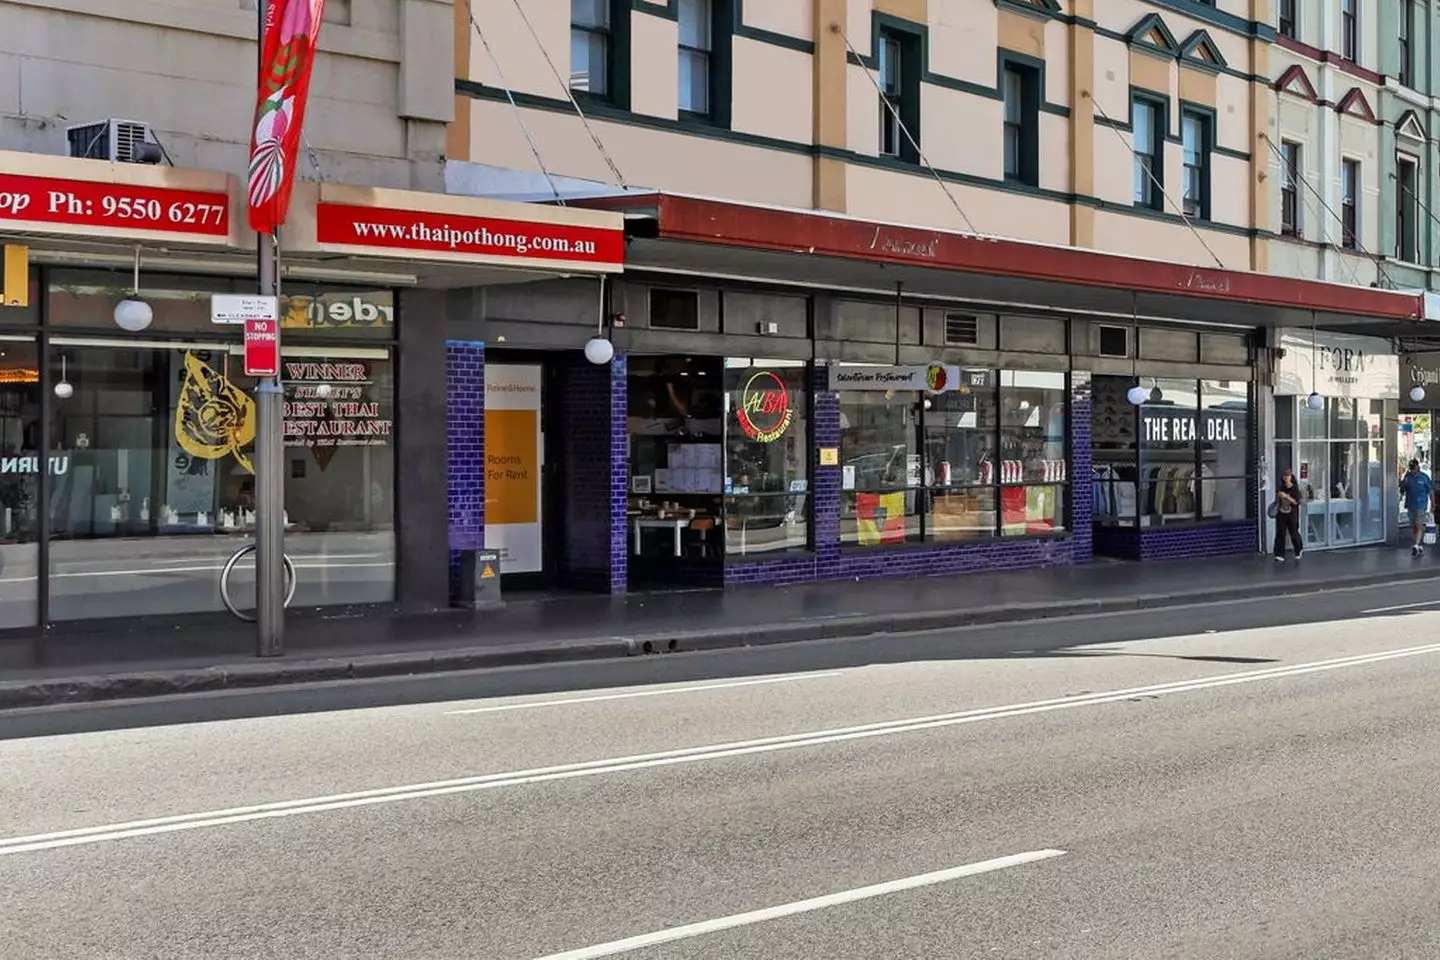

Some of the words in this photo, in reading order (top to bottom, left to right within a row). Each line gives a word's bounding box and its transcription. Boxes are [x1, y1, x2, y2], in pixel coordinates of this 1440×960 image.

[47, 191, 94, 215] Ph:
[102, 196, 162, 220] 9550
[168, 202, 225, 225] 6277
[353, 221, 597, 255] www.thaipothong.com.au
[254, 321, 268, 332] NO
[246, 333, 276, 341] STOPPING
[1319, 346, 1365, 372] FORA
[286, 363, 367, 380] WINNER
[283, 402, 327, 417] BEST
[332, 402, 379, 417] THAI
[746, 391, 787, 414] ALBA
[283, 420, 392, 435] ESTAURANT
[756, 409, 793, 442] Restaurant
[1144, 417, 1169, 441] THE
[1173, 417, 1205, 441] REA
[1208, 418, 1237, 441] DEAL
[487, 454, 522, 465] Rooms
[487, 469, 503, 480] For
[505, 469, 529, 480] Rent
